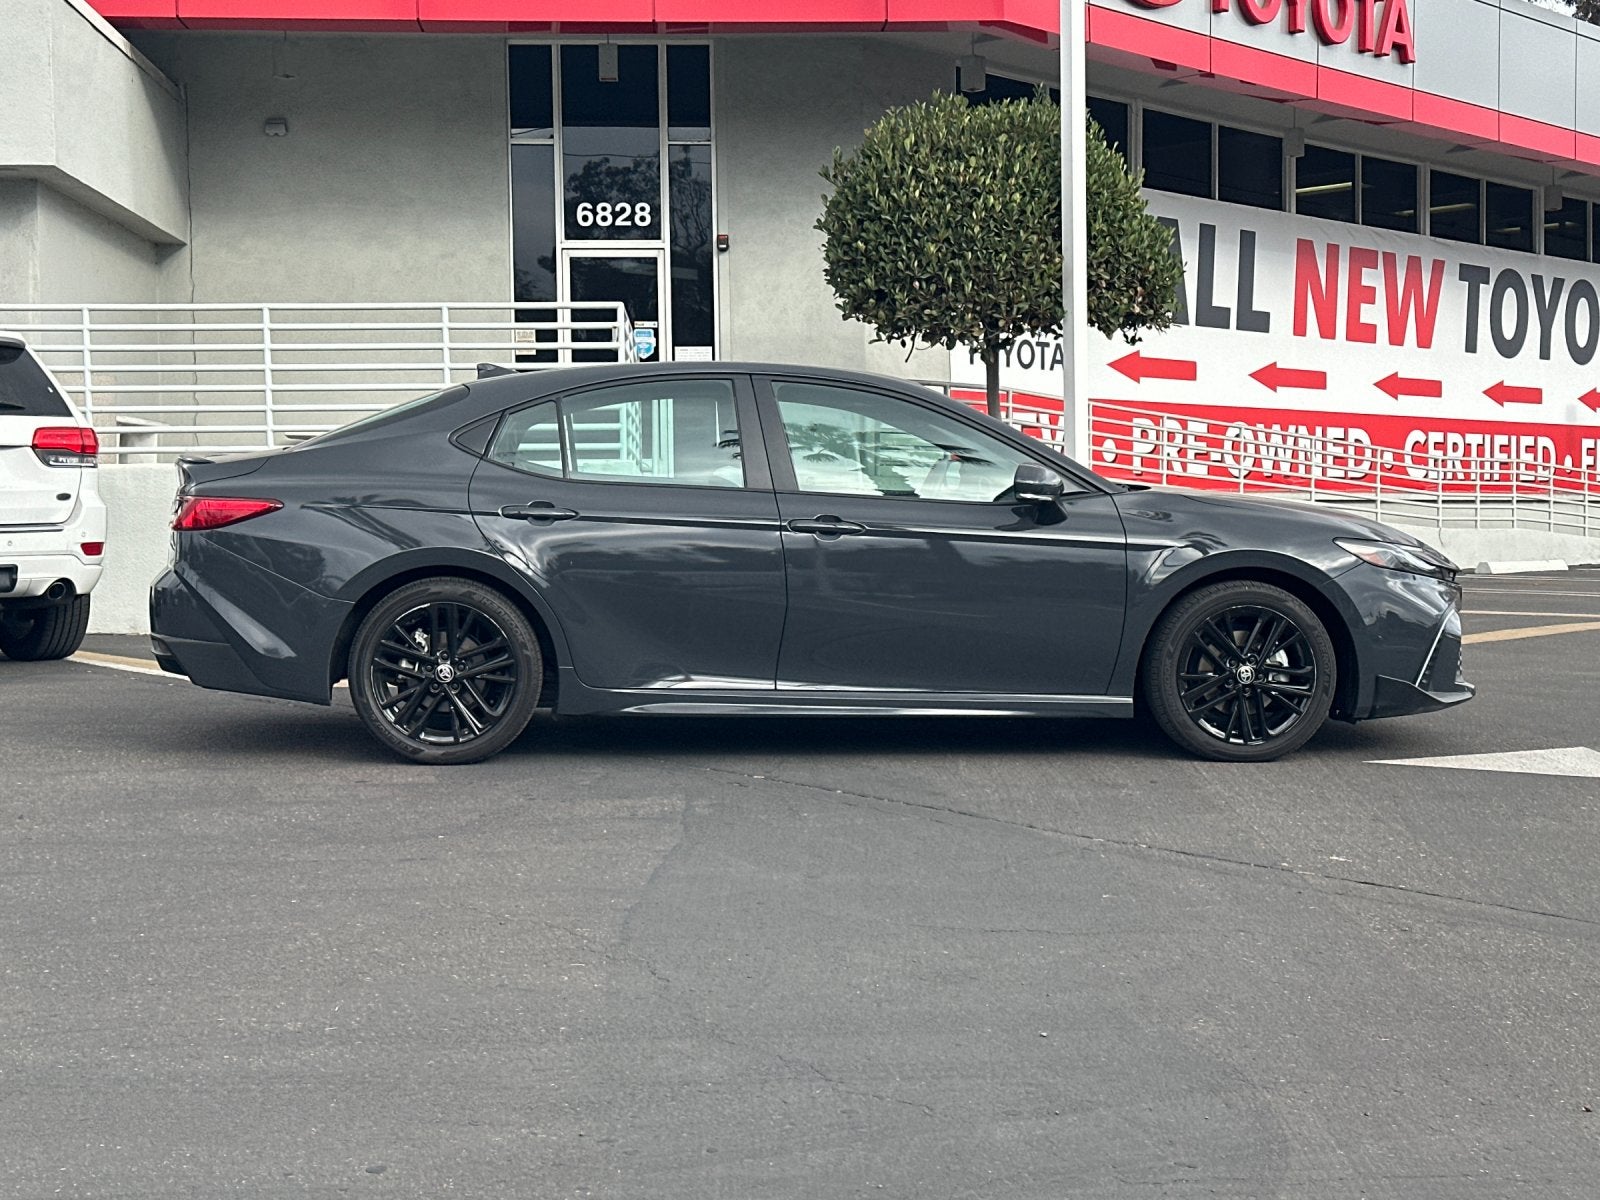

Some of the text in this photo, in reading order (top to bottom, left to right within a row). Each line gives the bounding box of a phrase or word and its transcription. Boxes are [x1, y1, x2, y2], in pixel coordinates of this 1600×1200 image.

[576, 202, 651, 227] 6828
[1293, 238, 1445, 349] NEW
[1132, 417, 1373, 480] PRE-OWNED
[1403, 429, 1557, 481] CERTIFIED
